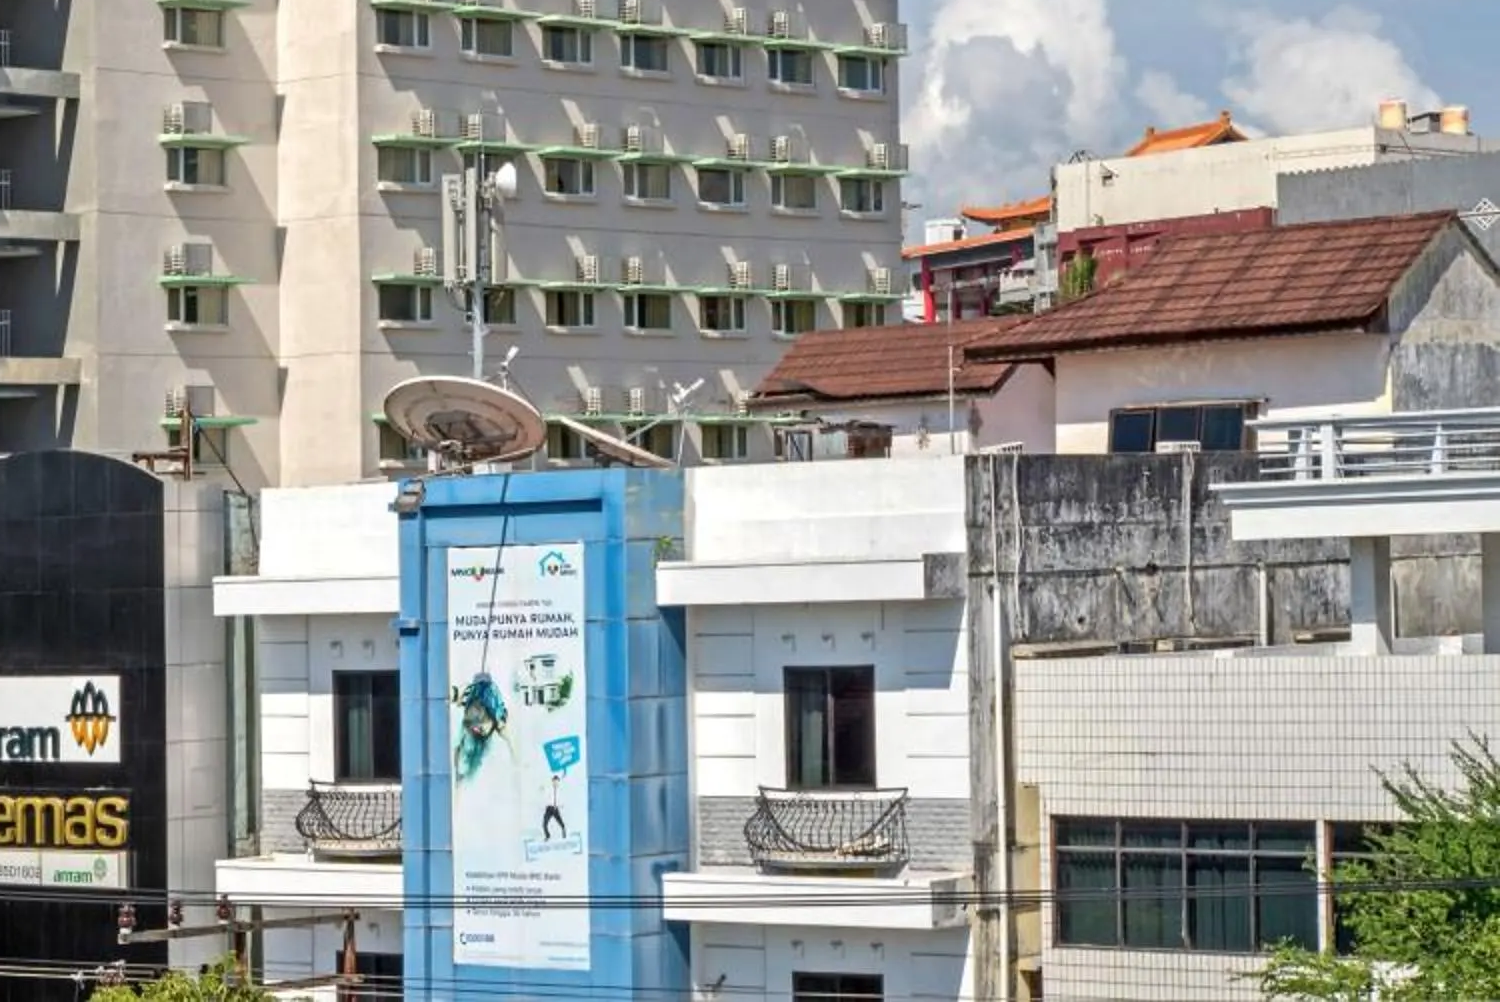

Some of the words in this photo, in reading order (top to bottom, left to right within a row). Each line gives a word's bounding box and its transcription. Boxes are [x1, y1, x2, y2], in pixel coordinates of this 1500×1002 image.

[490, 613, 527, 625] PUNYA
[453, 629, 489, 641] PUNYA
[492, 628, 533, 640] RUMAH
